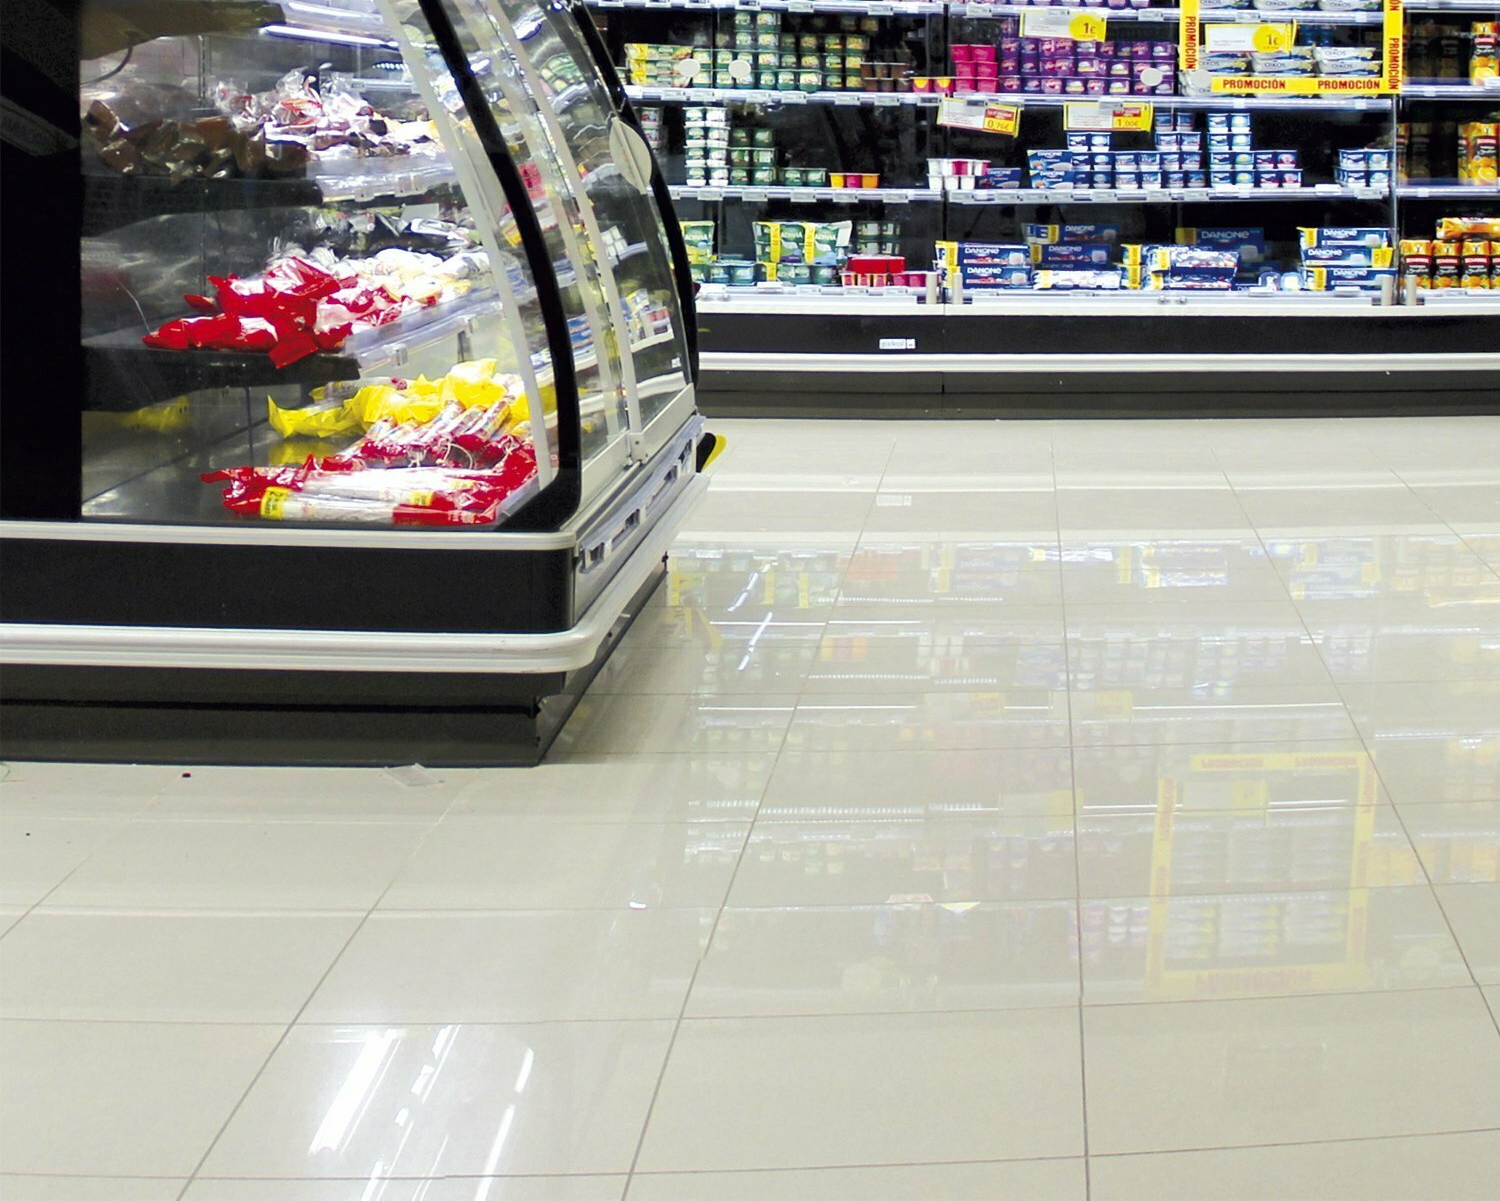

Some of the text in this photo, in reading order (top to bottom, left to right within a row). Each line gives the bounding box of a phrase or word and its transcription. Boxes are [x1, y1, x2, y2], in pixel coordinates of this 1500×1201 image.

[1184, 16, 1197, 70] PROMOCIÓN
[1388, 38, 1400, 90] PROMOCIÓN
[1222, 77, 1286, 89] PROMOCIÓN
[1317, 77, 1381, 90] PROMOCIÓN
[1201, 230, 1250, 239] DANONE
[1323, 229, 1359, 238] DANONE
[965, 247, 1000, 255] DANONE
[1308, 248, 1343, 257] DANONE
[967, 267, 1002, 275] DANONE
